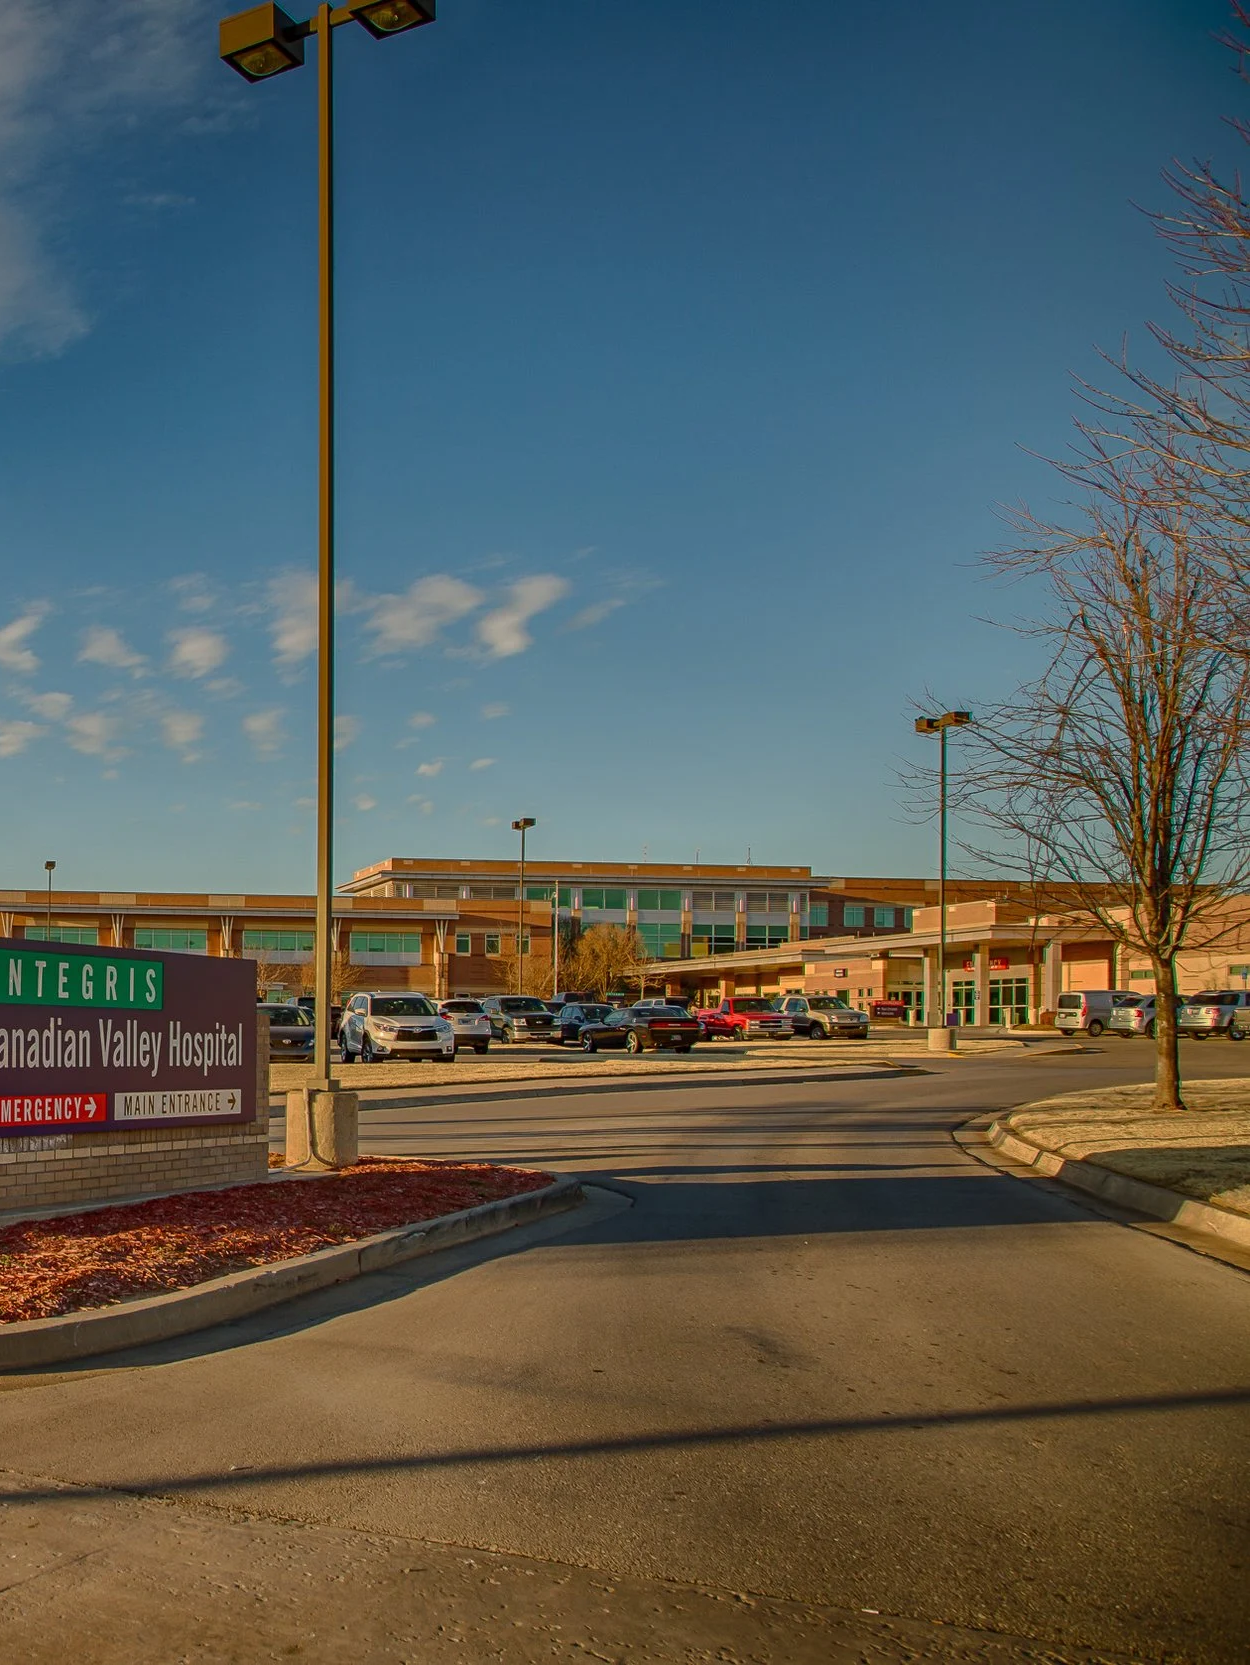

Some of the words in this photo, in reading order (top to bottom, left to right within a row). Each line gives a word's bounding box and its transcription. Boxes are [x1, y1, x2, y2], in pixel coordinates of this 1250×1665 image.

[99, 1019, 162, 1077] Valley
[169, 1021, 243, 1076] Hospital
[123, 1096, 156, 1117] MAIN
[161, 1092, 221, 1114] ENTRANCE
